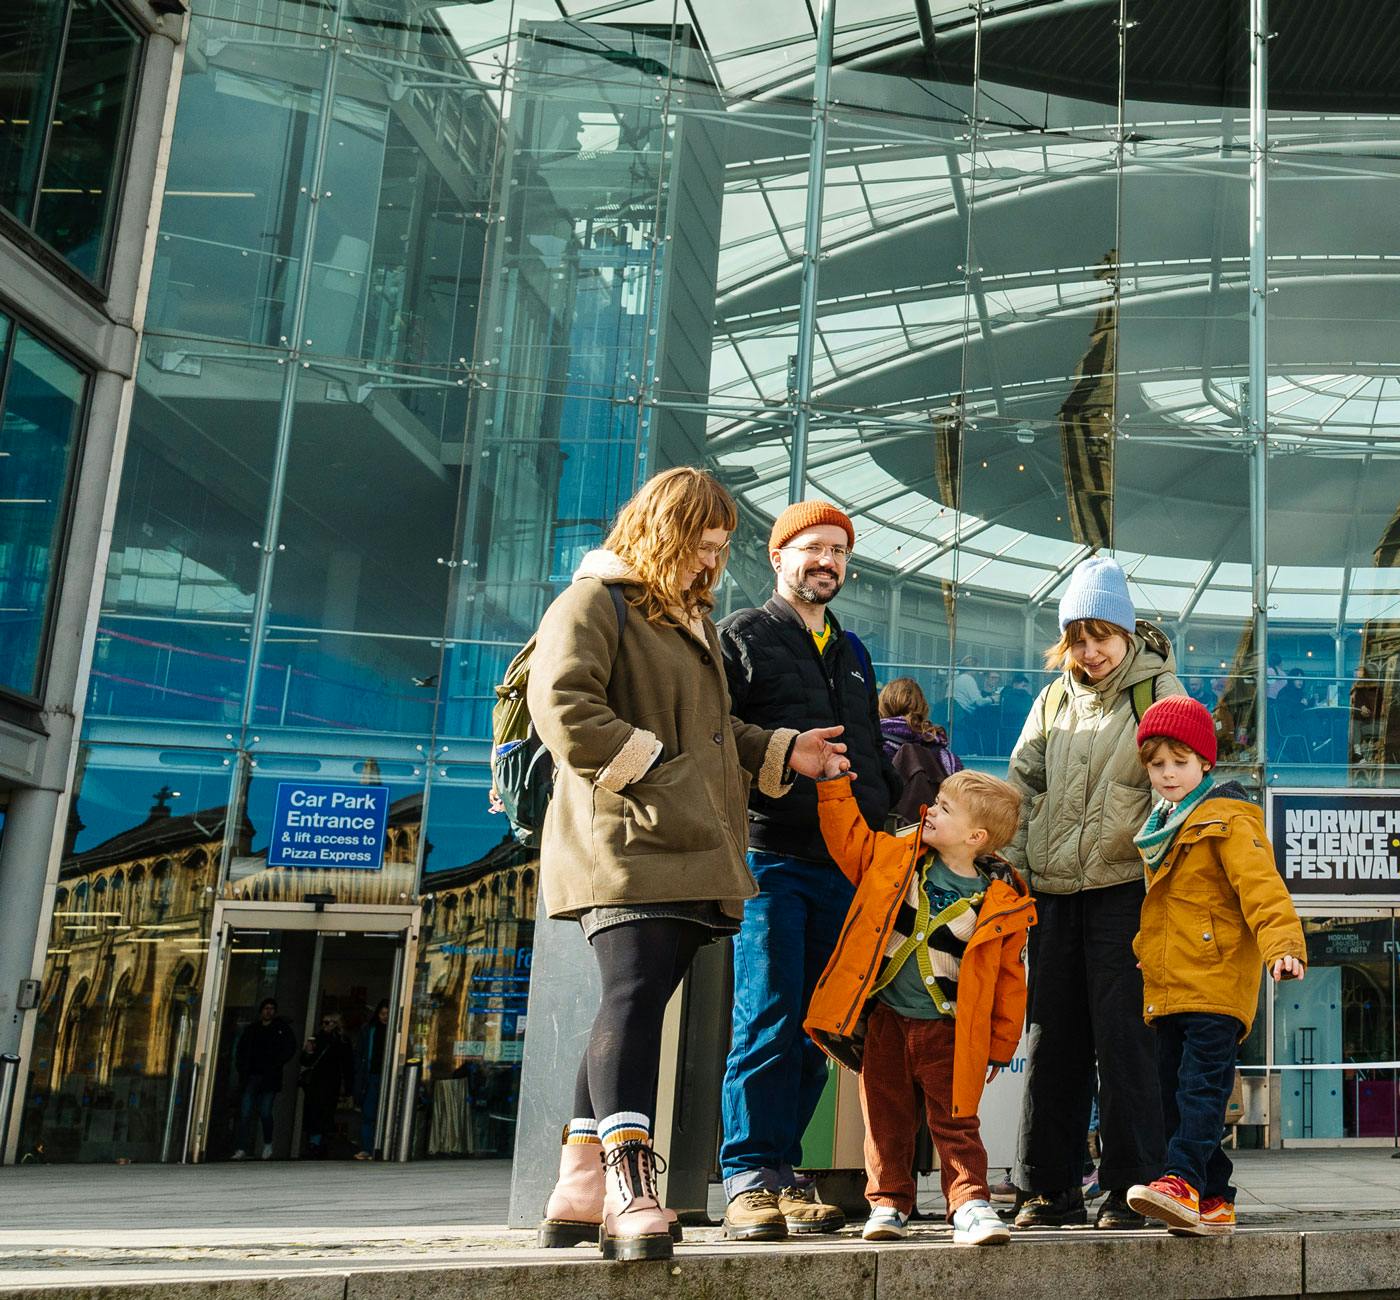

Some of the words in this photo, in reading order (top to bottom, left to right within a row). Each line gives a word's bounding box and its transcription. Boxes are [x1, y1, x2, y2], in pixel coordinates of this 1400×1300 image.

[290, 790, 326, 807] Car
[331, 792, 376, 809] Park
[287, 811, 375, 829] Entrance
[281, 831, 291, 842] &
[294, 832, 311, 843] lift
[314, 834, 359, 845] access
[362, 836, 376, 846] to
[1285, 833, 1390, 856] SCIENCE
[282, 847, 317, 859] Pizza
[320, 848, 372, 862] Express
